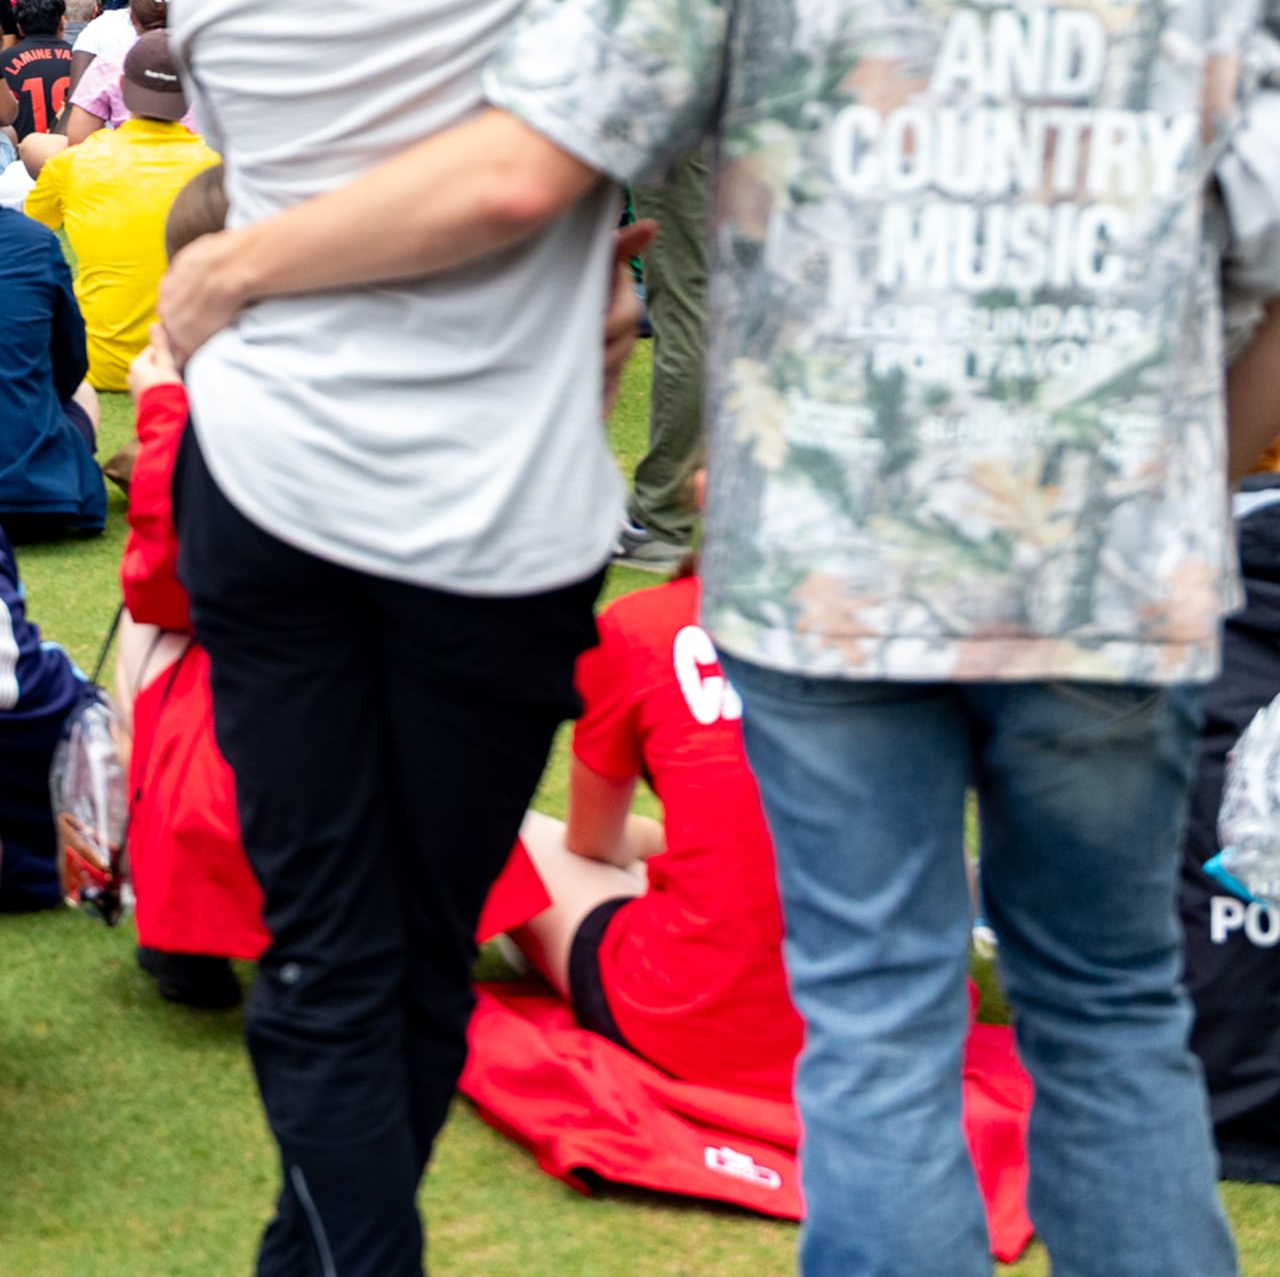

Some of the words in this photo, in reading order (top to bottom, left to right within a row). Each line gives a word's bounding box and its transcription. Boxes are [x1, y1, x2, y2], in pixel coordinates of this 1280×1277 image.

[5, 48, 52, 75] LAMINE
[932, 7, 1107, 97] AND
[829, 104, 1201, 195] COUNTRY
[877, 203, 1125, 292] MUSIC
[672, 625, 744, 725] C
